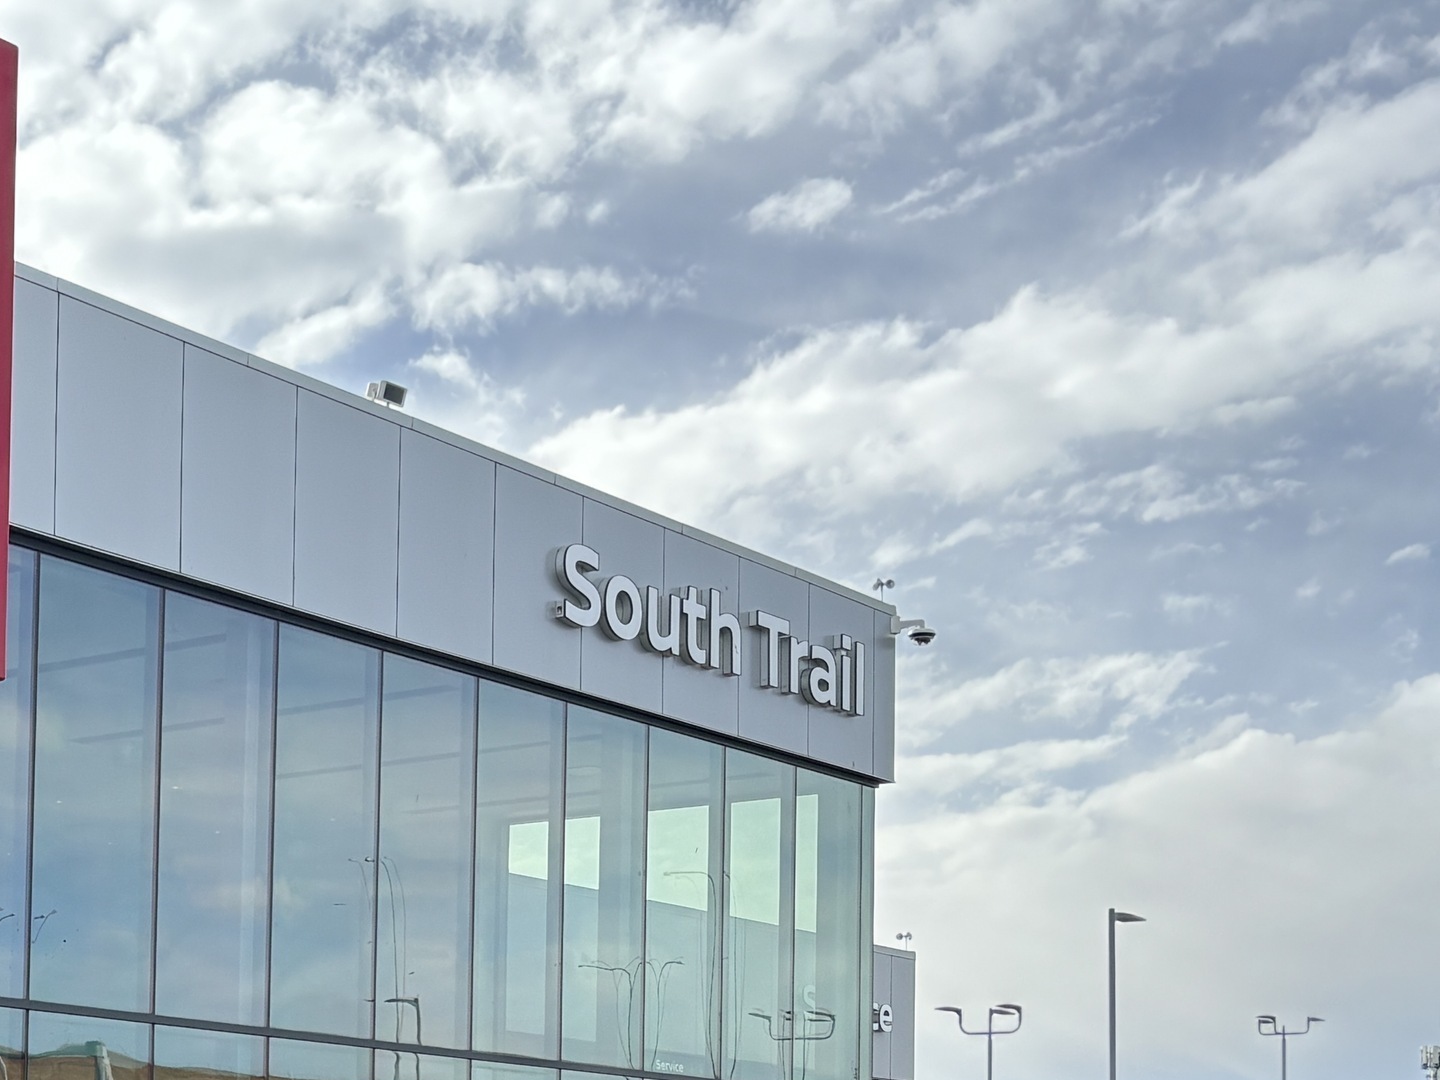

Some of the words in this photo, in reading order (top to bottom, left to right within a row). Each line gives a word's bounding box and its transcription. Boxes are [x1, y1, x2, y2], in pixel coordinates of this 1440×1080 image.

[556, 543, 742, 677] South
[749, 609, 865, 716] Trail
[655, 1059, 684, 1073] Service
